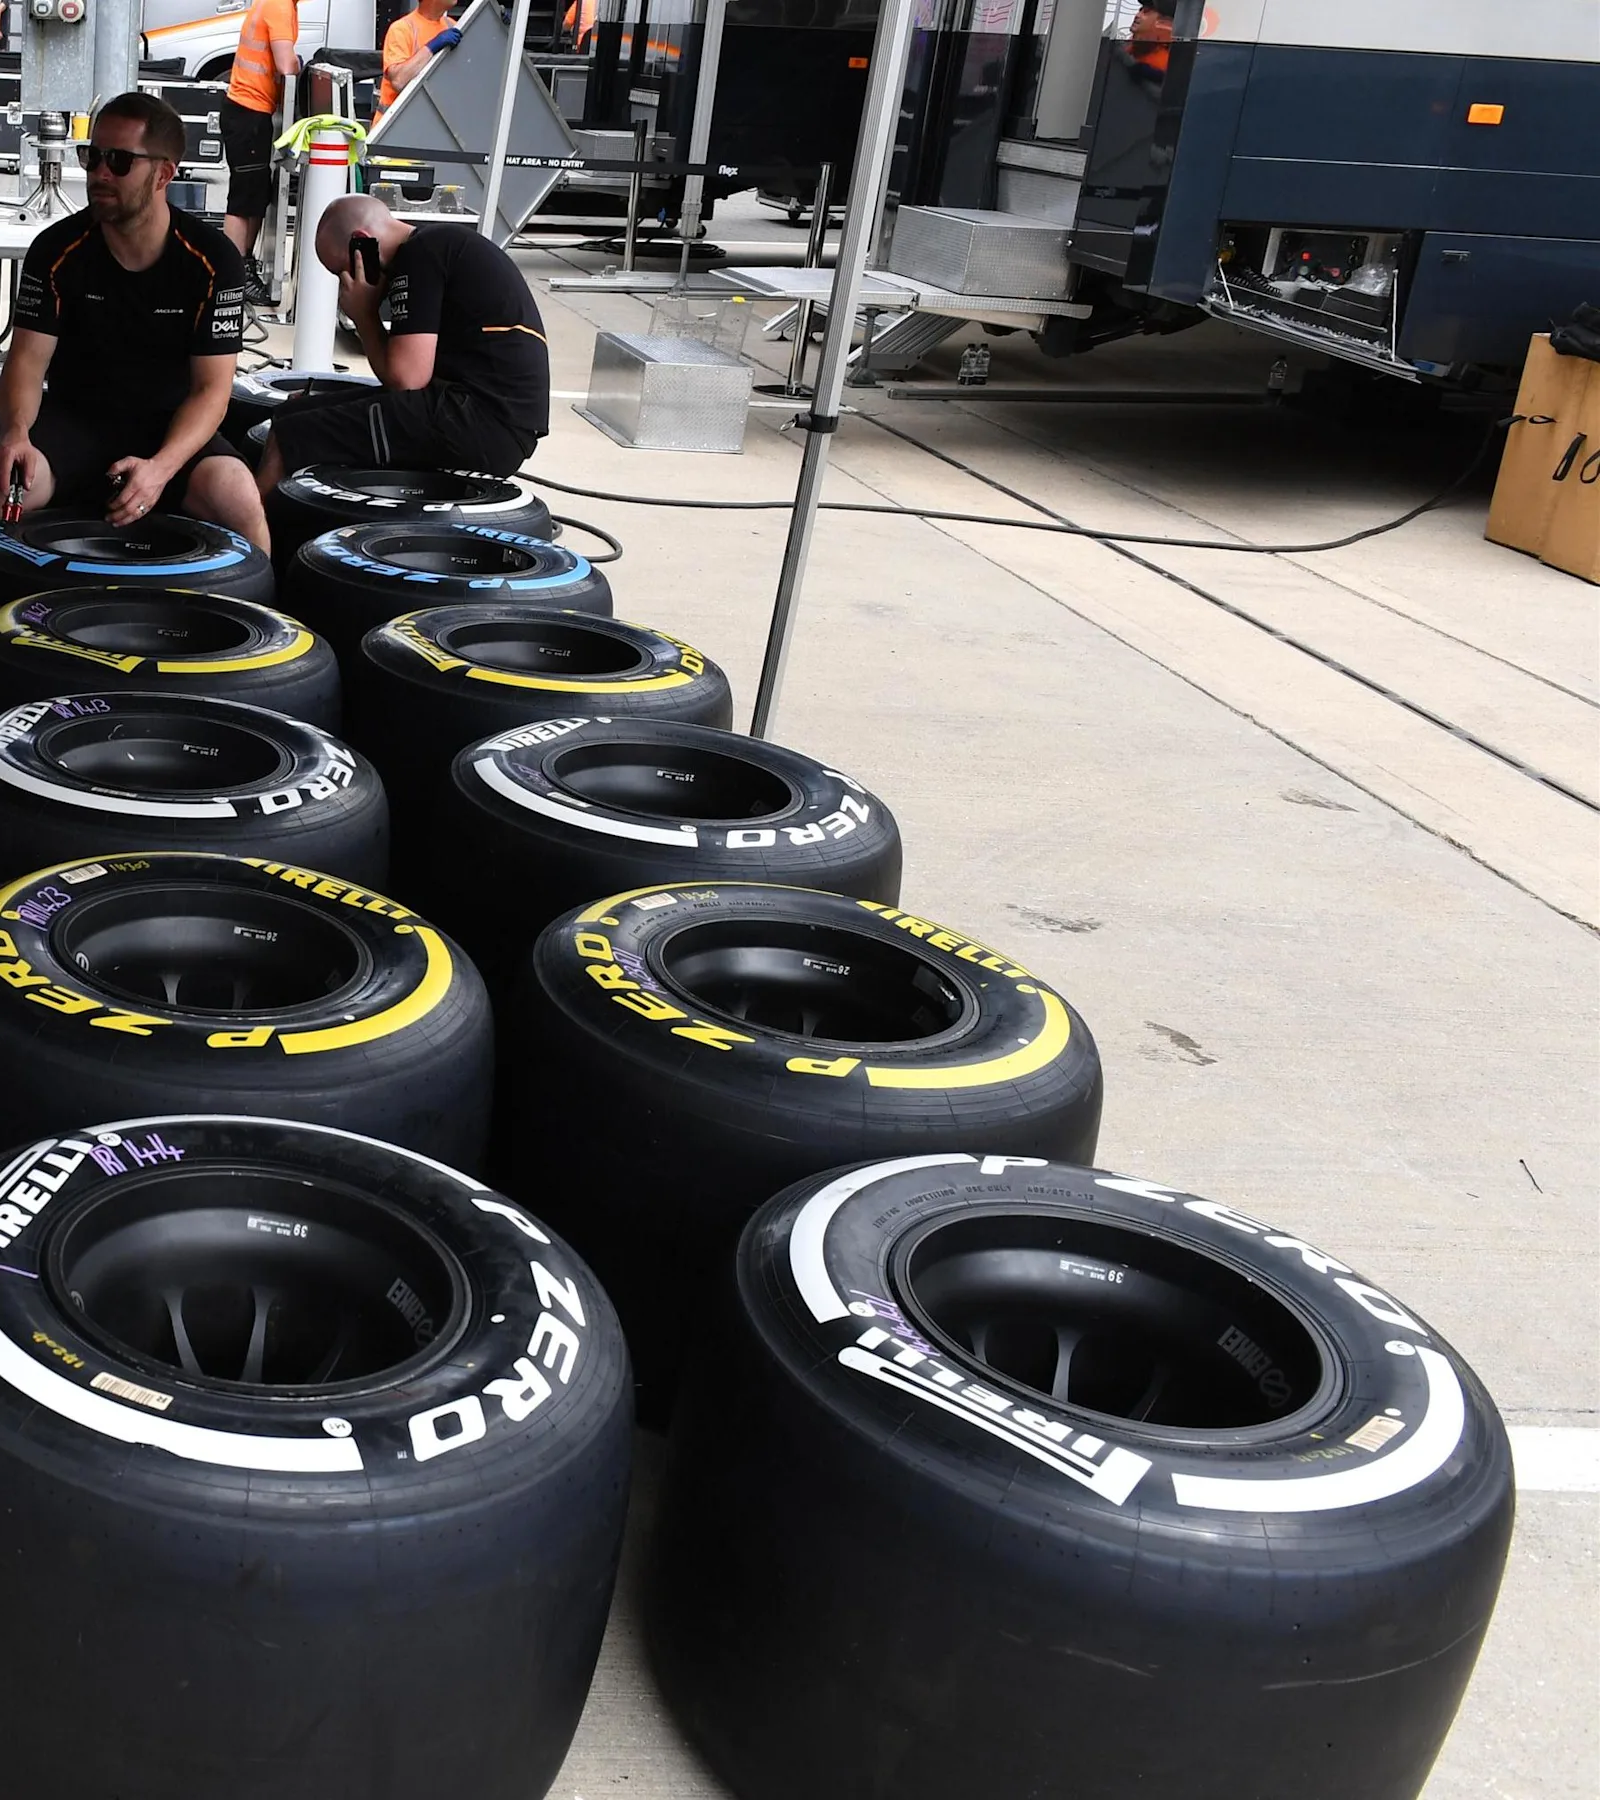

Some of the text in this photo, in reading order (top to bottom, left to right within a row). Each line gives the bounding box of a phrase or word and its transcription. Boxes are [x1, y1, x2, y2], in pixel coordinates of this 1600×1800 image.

[506, 156, 520, 165] HAT
[521, 157, 541, 166] AREA
[548, 159, 560, 167] NO
[561, 160, 585, 168] ENTRY
[220, 291, 243, 301] Hilton
[212, 319, 240, 332] DELL
[295, 477, 454, 512] P ZERO
[322, 545, 507, 589] P ZERO
[476, 717, 590, 752] PIRELLI
[260, 743, 357, 816] ZERO
[725, 769, 870, 848] P ZERO
[240, 857, 421, 919] PIRELLI
[265, 931, 277, 942] 26
[855, 899, 1044, 981] PIRELLI
[576, 932, 863, 1078] P ZERO
[206, 1026, 276, 1048] P
[293, 1223, 308, 1238] 39
[980, 1156, 1429, 1338] P ZERO
[1107, 1270, 1124, 1285] 39
[408, 1197, 589, 1462] P ZERO
[1218, 1324, 1273, 1380] ENKEI
[838, 1326, 1153, 1507] PIRELLI
